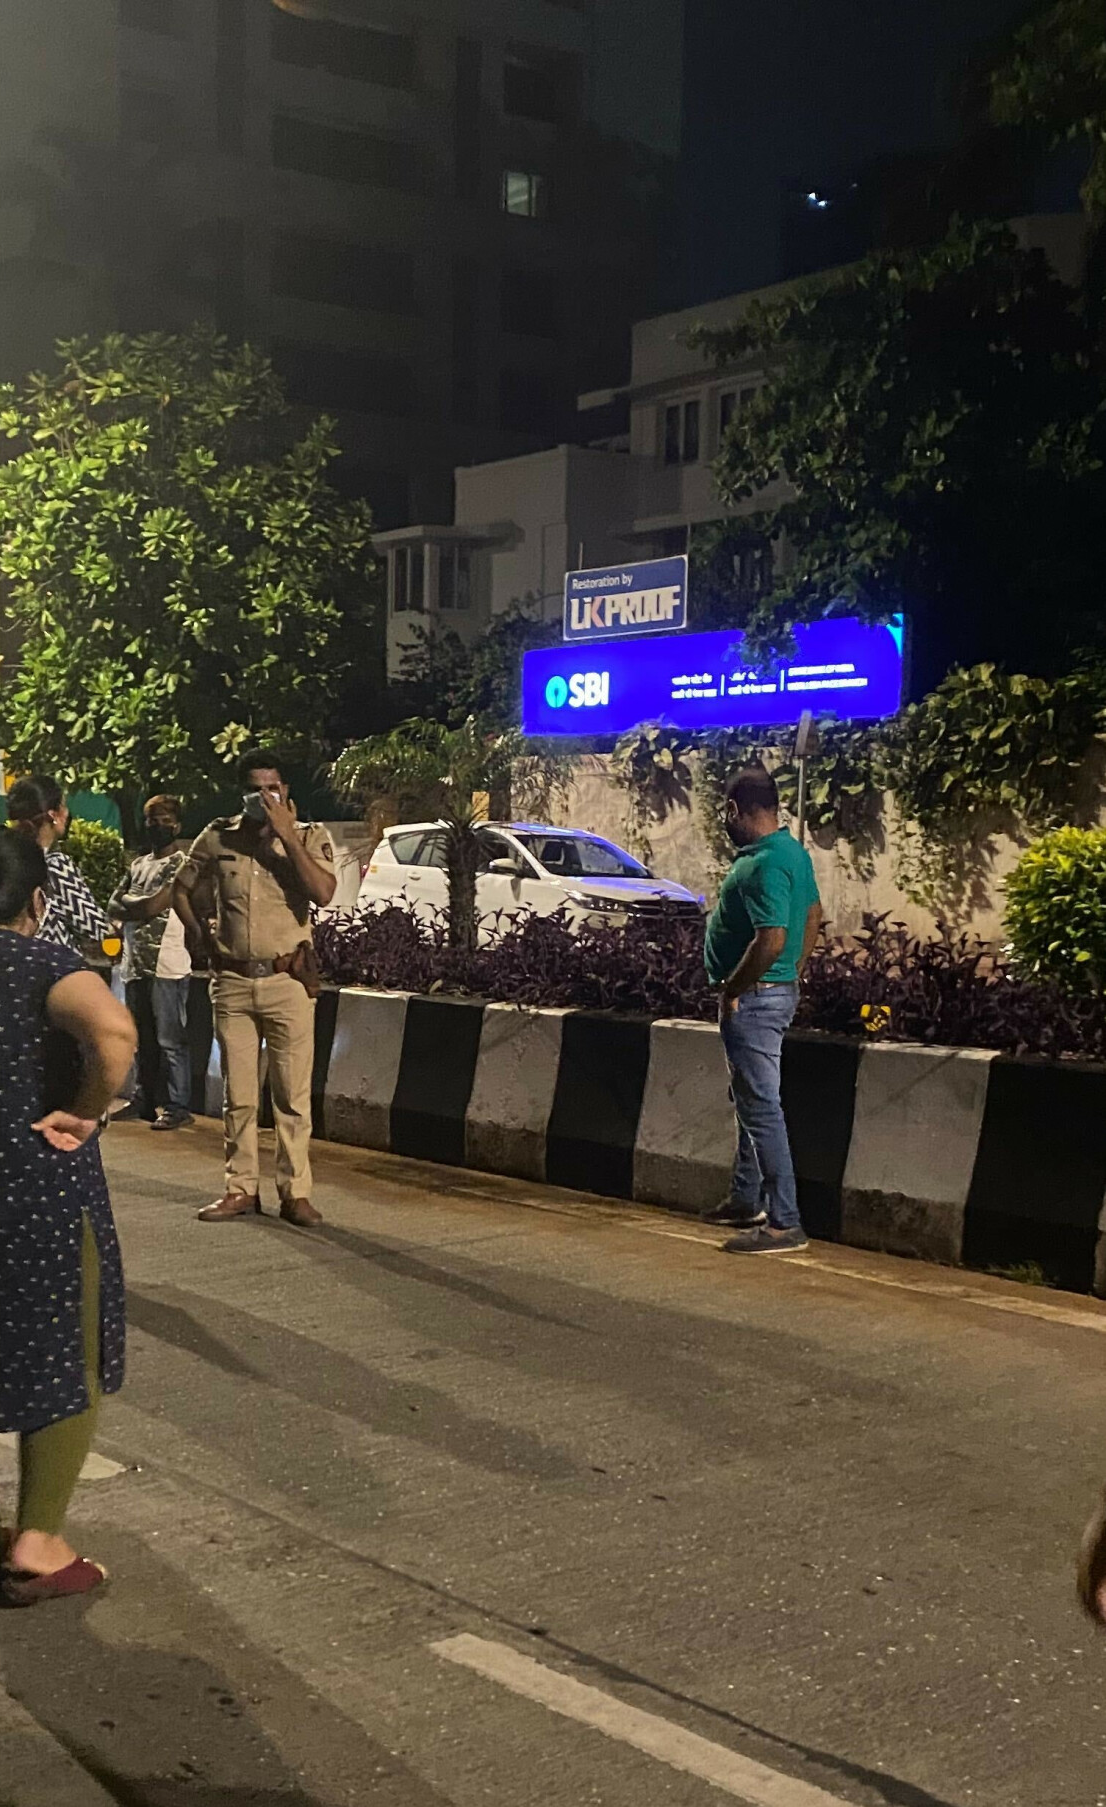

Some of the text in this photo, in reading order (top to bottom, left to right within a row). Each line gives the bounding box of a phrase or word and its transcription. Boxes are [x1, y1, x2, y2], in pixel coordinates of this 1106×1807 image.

[572, 573, 633, 590] Restoration by
[568, 671, 610, 708] SBI
